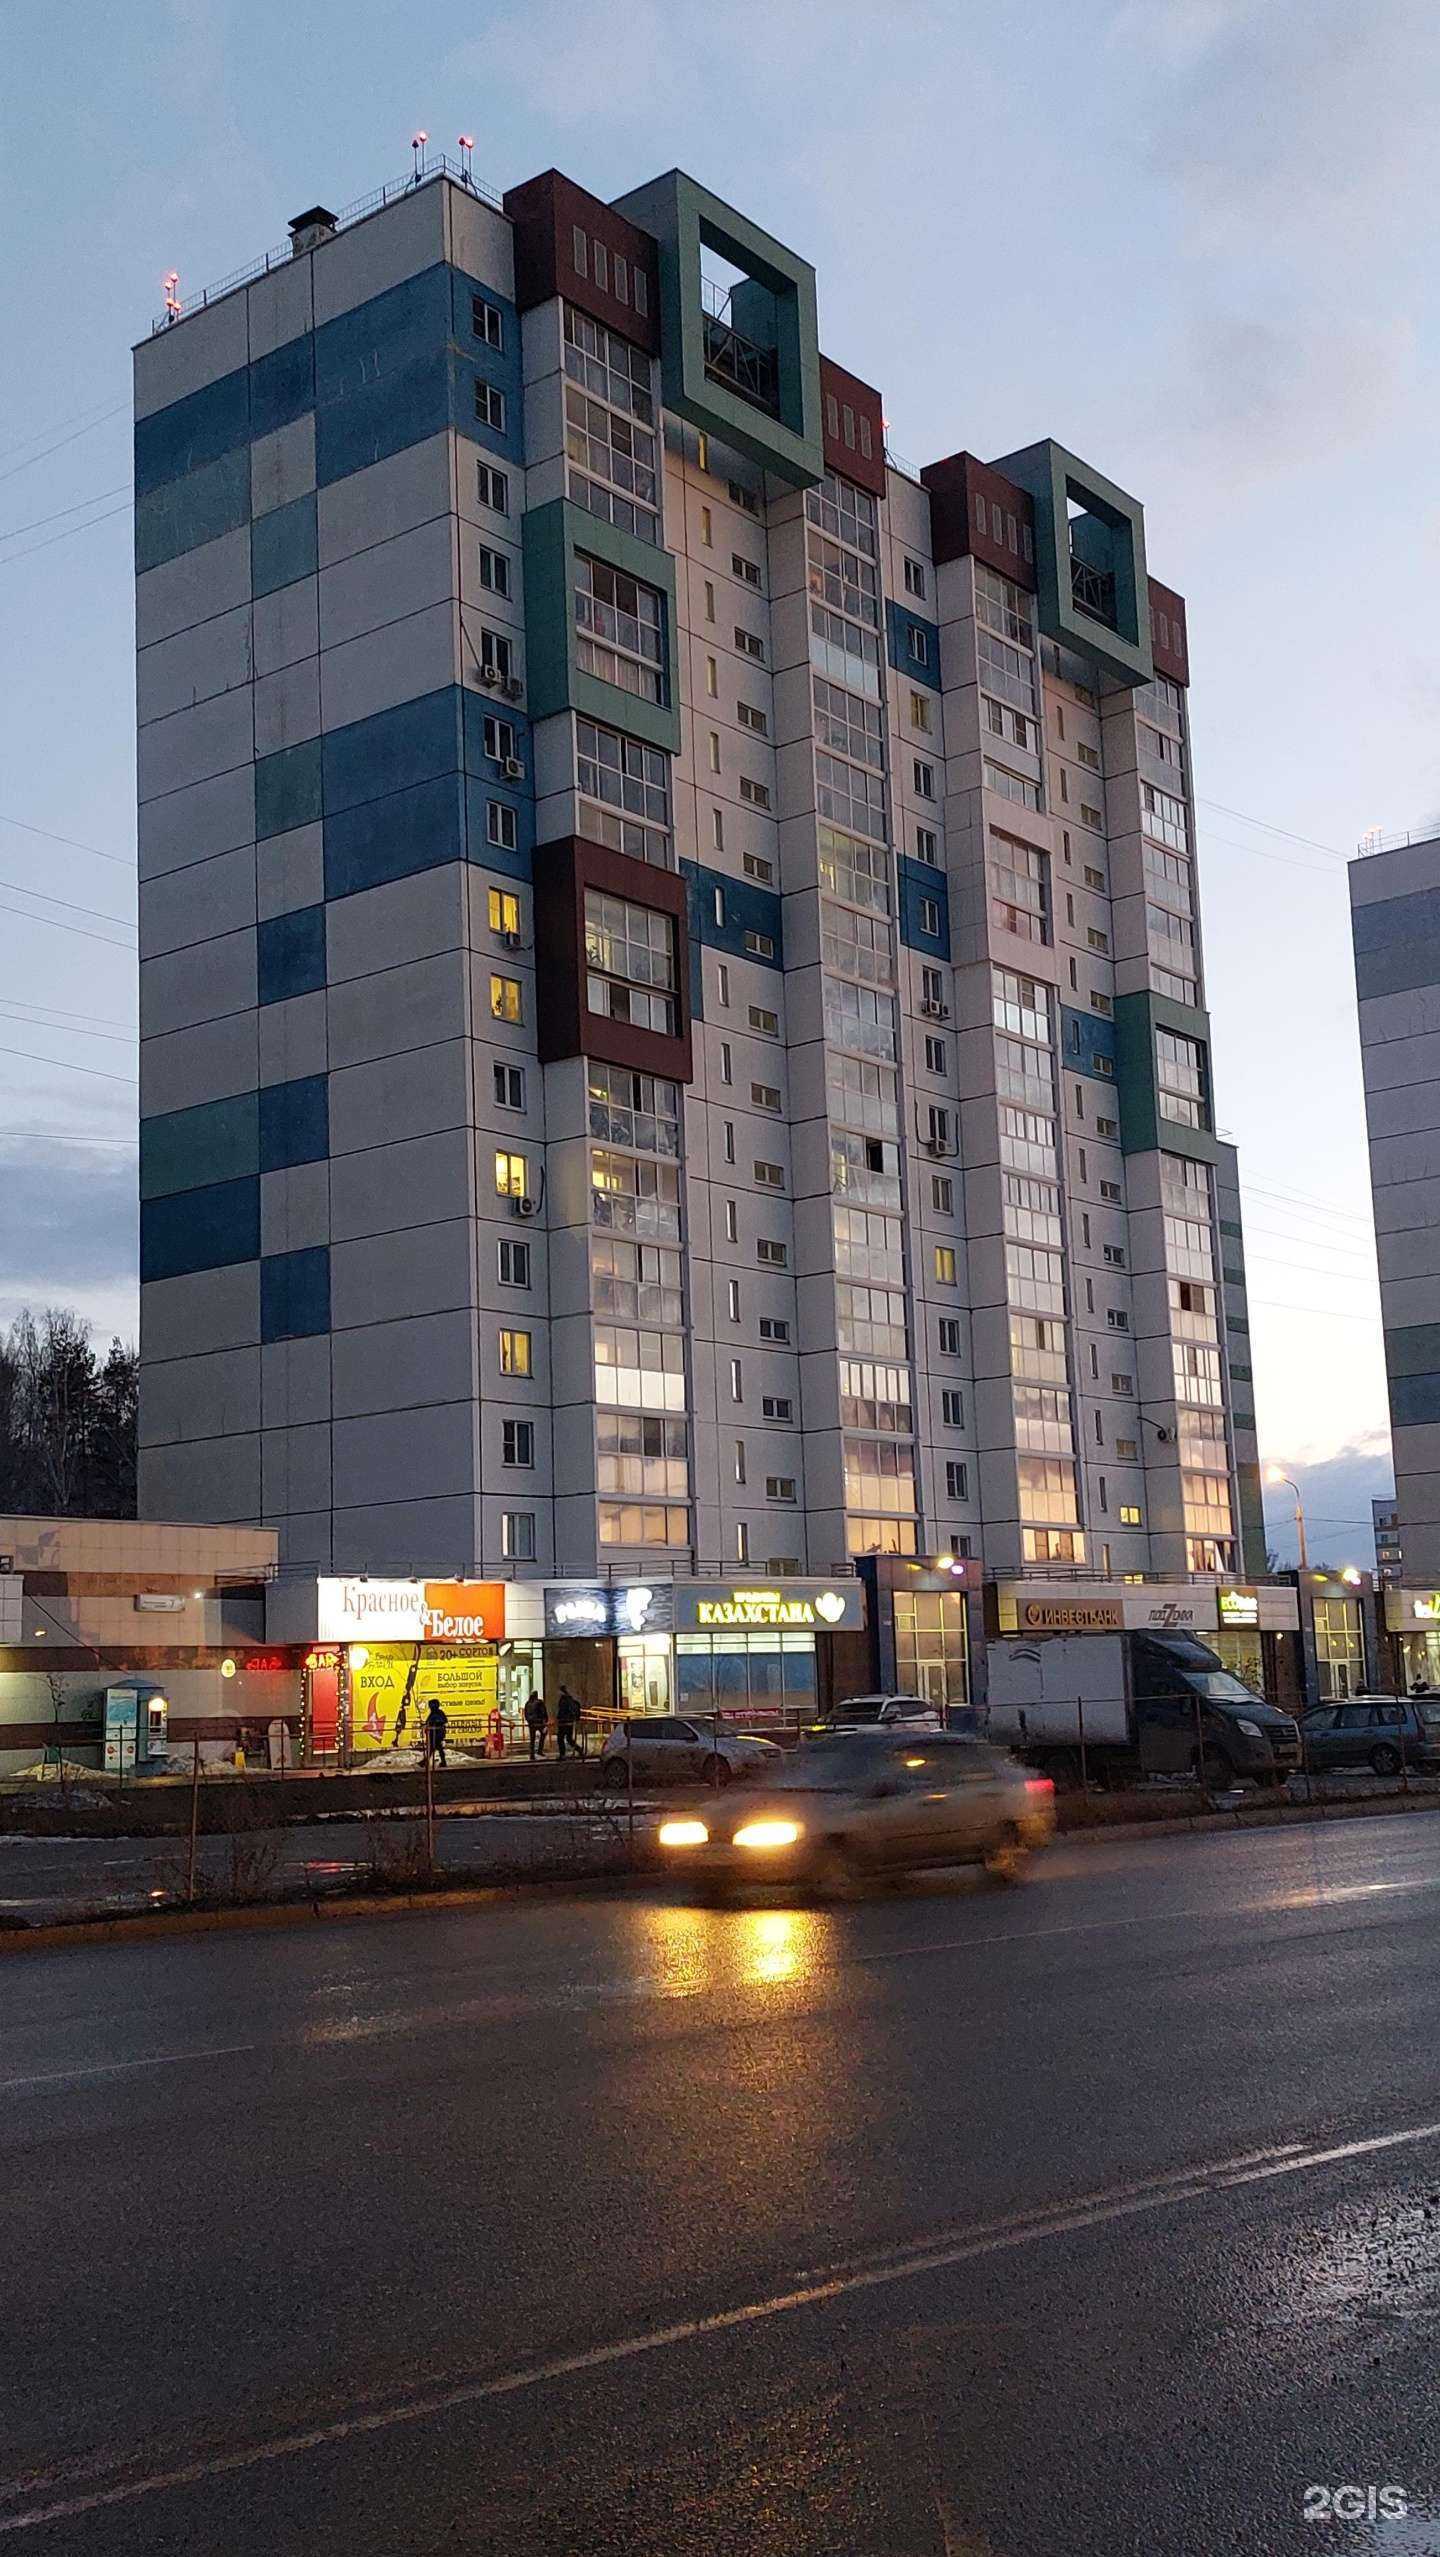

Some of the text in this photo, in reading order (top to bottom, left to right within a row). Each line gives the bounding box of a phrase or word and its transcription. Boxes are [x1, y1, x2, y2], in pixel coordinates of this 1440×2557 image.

[343, 1586, 419, 1620] Красное
[430, 1609, 484, 1637] Белое
[699, 1602, 815, 1624] КАЗАХСТАНА
[1042, 1608, 1119, 1625] ИНВЕСТБАНК
[360, 1675, 395, 1689] ВХОД
[437, 1671, 483, 1682] БОЛЬШОЙ
